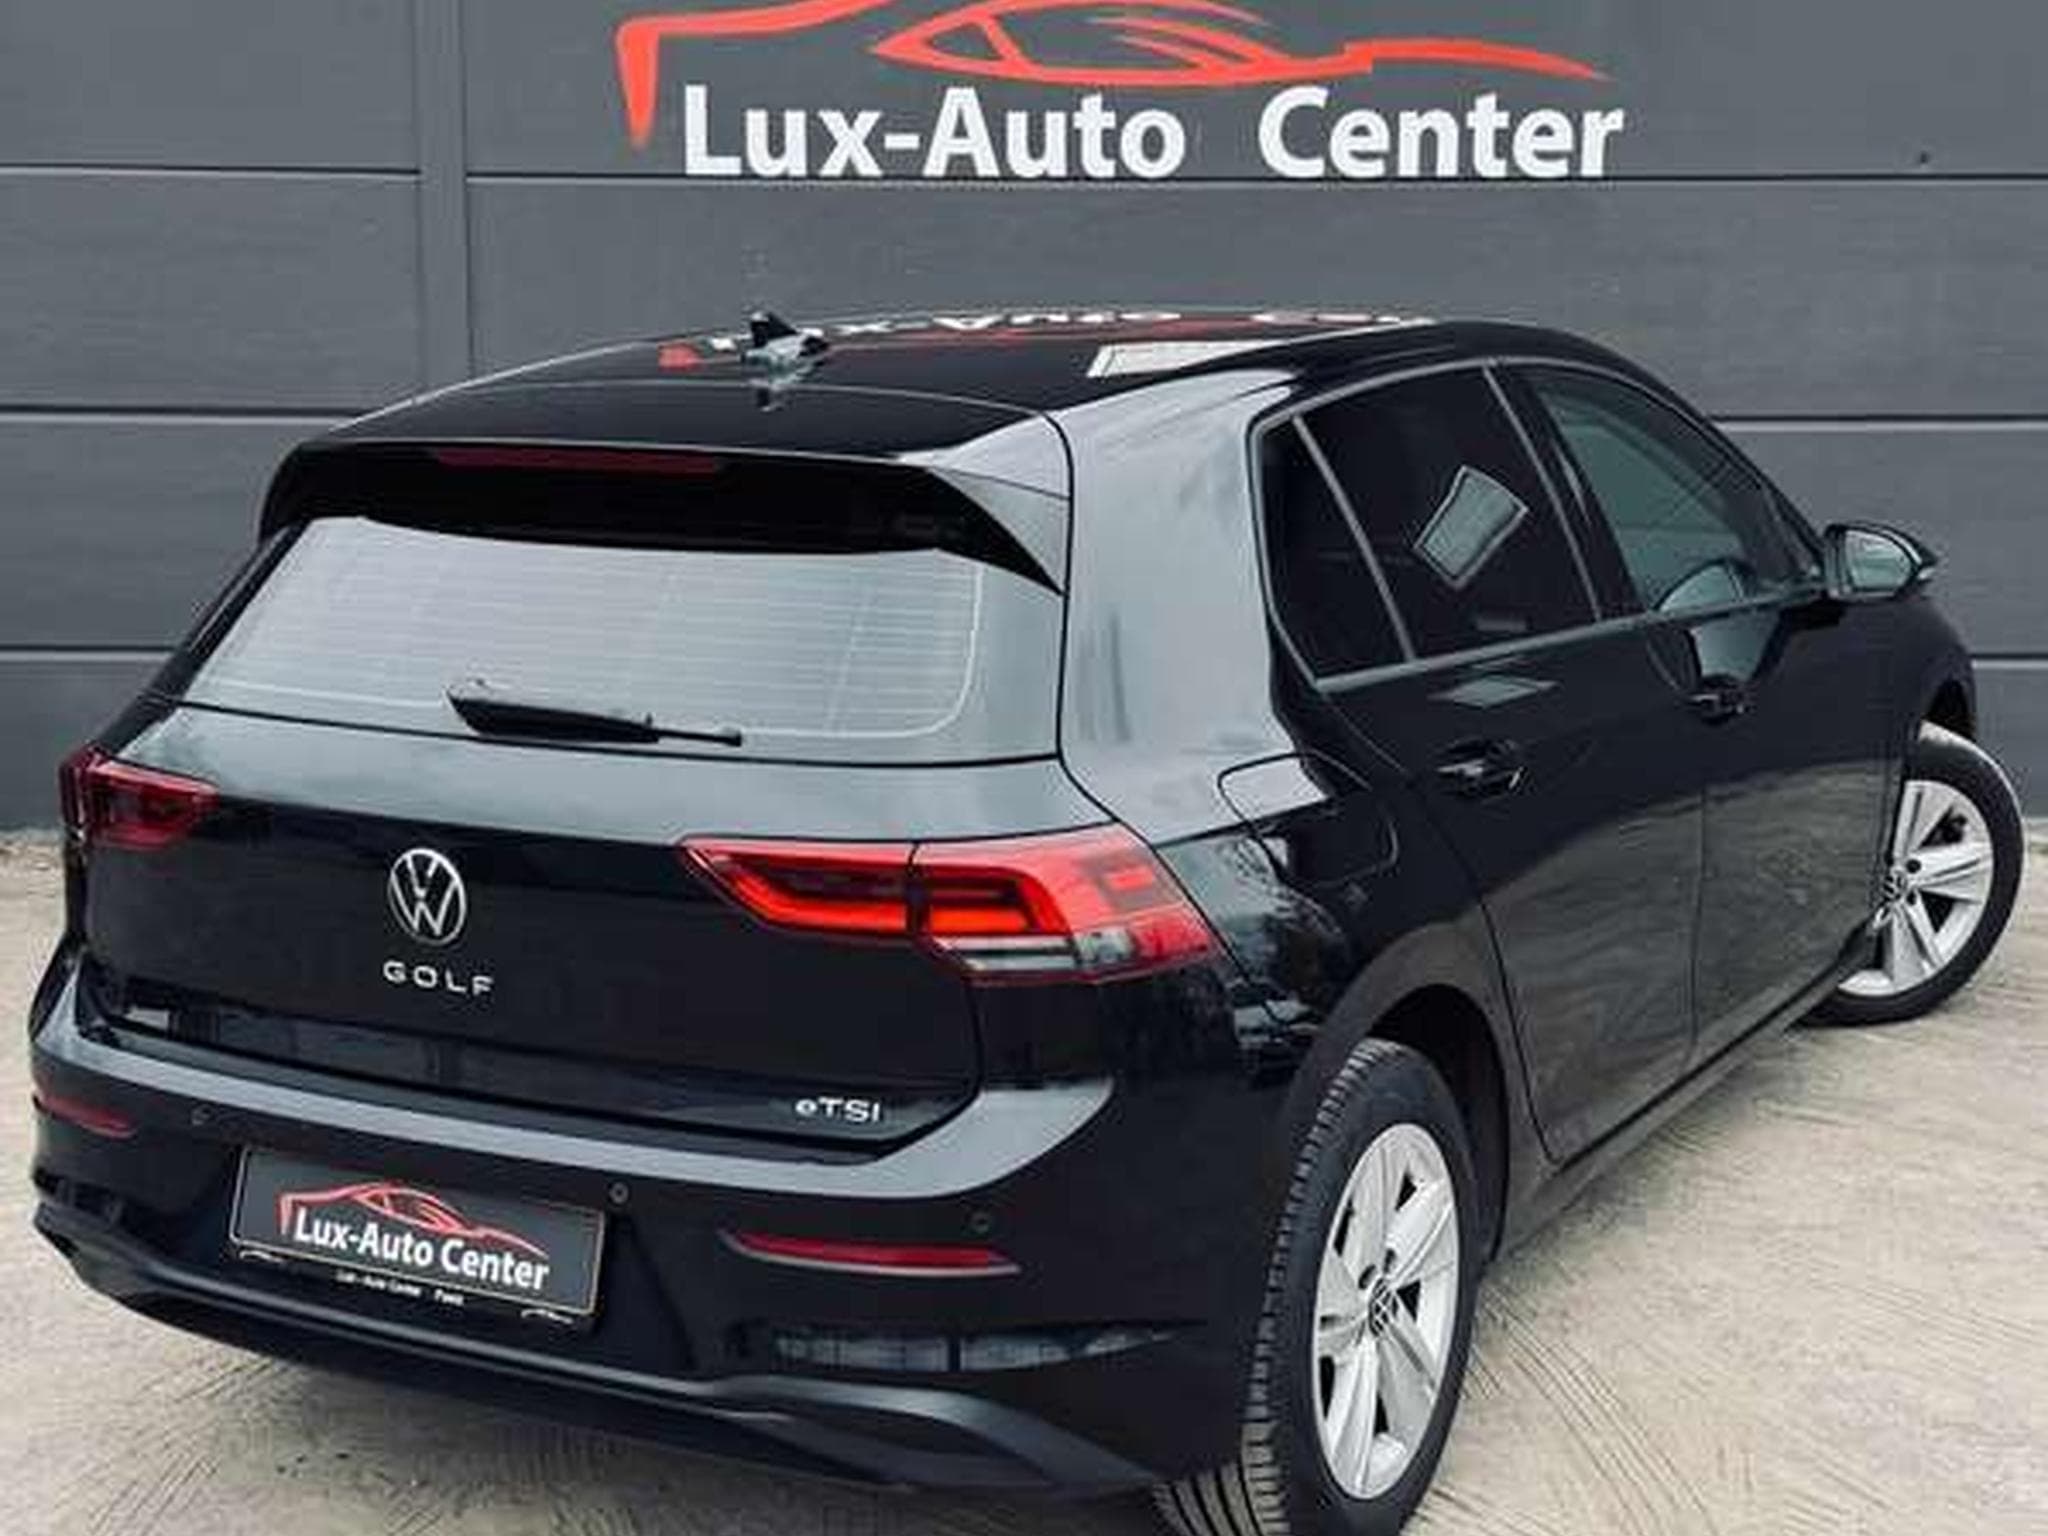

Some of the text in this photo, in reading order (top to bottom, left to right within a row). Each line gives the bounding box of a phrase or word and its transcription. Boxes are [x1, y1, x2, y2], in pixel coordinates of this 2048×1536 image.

[685, 85, 1624, 179] Lux-Auto Center
[383, 960, 493, 996] GOLF
[295, 1207, 433, 1267] Lux-Auto
[440, 1239, 550, 1290] Center
